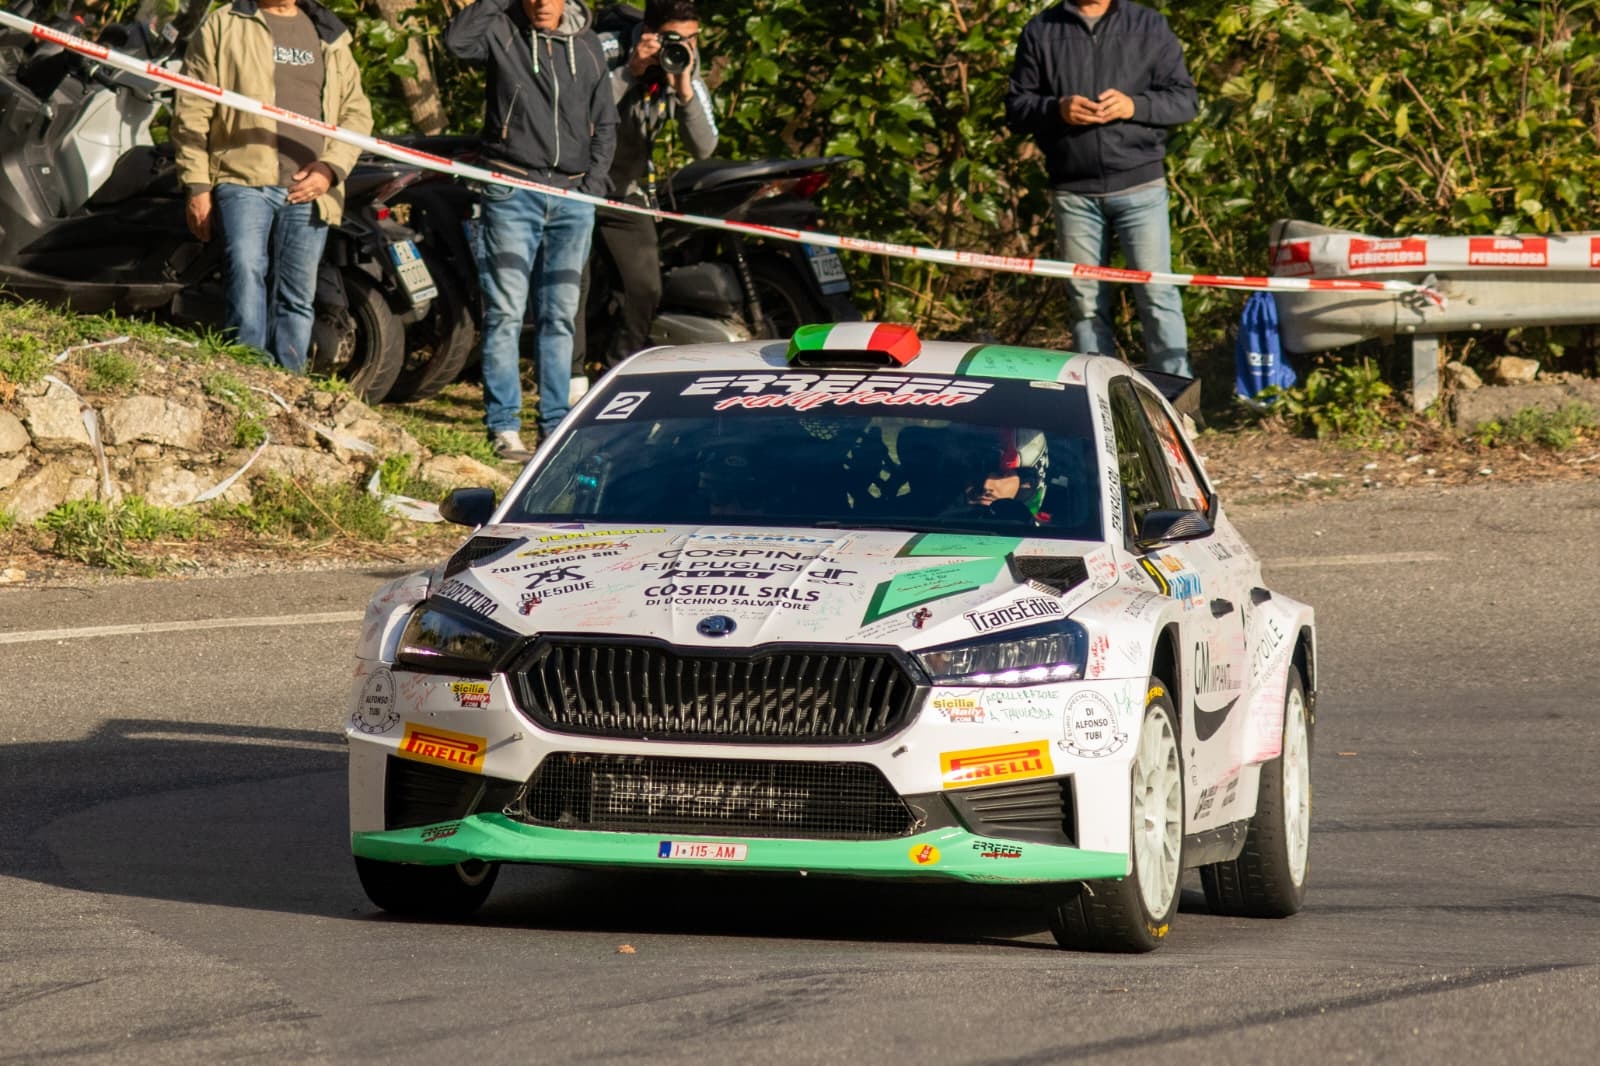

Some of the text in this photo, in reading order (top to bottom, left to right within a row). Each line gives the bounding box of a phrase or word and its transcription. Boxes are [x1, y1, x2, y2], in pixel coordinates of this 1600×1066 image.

[1350, 251, 1425, 266] PERICOLOSA
[1470, 252, 1546, 265] PERICOLOSA
[602, 395, 642, 416] 2
[491, 554, 587, 574] ZOOTECNICA
[520, 581, 595, 601] DUE5DUE
[644, 583, 821, 602] COSEDIL SRLS
[665, 597, 728, 606] UCCHINO
[731, 599, 811, 611] SALVATORE
[453, 683, 485, 694] Sicilia
[933, 698, 974, 709] Sicilia
[1085, 707, 1094, 716] DI
[1075, 718, 1108, 729] ALFONSO
[1084, 731, 1103, 740] TUBI
[405, 731, 480, 765] PIRELLI
[949, 748, 1043, 781] PIRELLI
